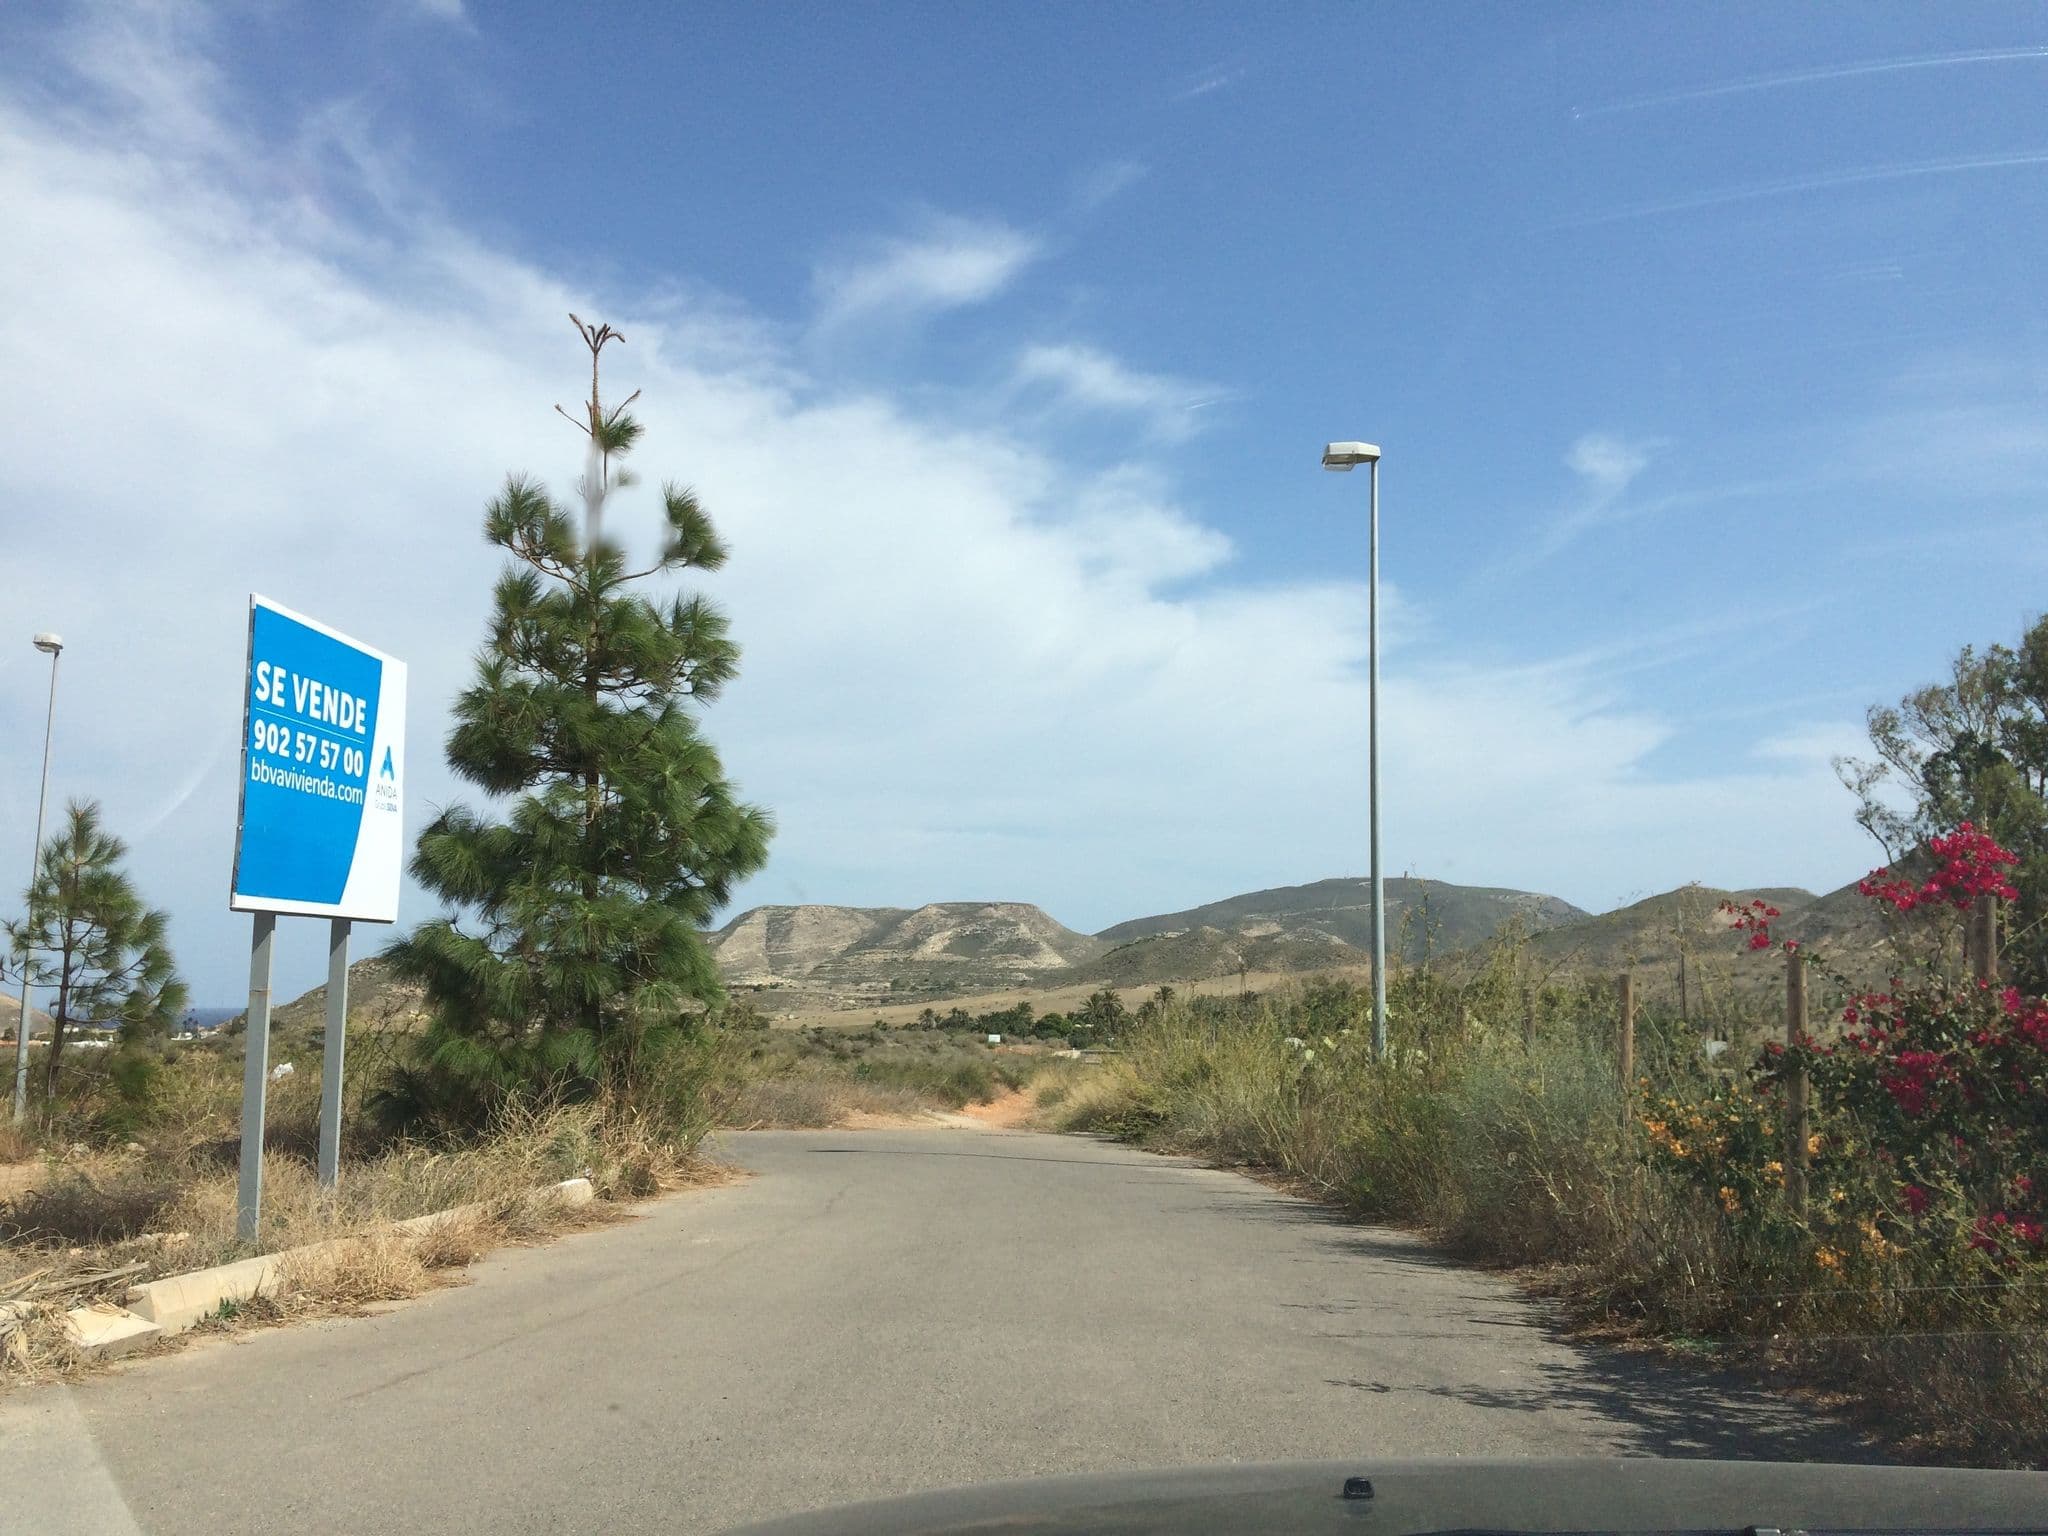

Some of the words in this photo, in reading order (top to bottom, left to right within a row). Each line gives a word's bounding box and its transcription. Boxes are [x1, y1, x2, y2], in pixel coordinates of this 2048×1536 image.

[254, 660, 287, 708] SE
[292, 673, 367, 735] VENDE
[254, 718, 291, 758] 902
[295, 731, 317, 764] 57
[319, 739, 340, 771] 57
[343, 747, 364, 778] 00
[251, 756, 363, 805] bbvavivienda.com
